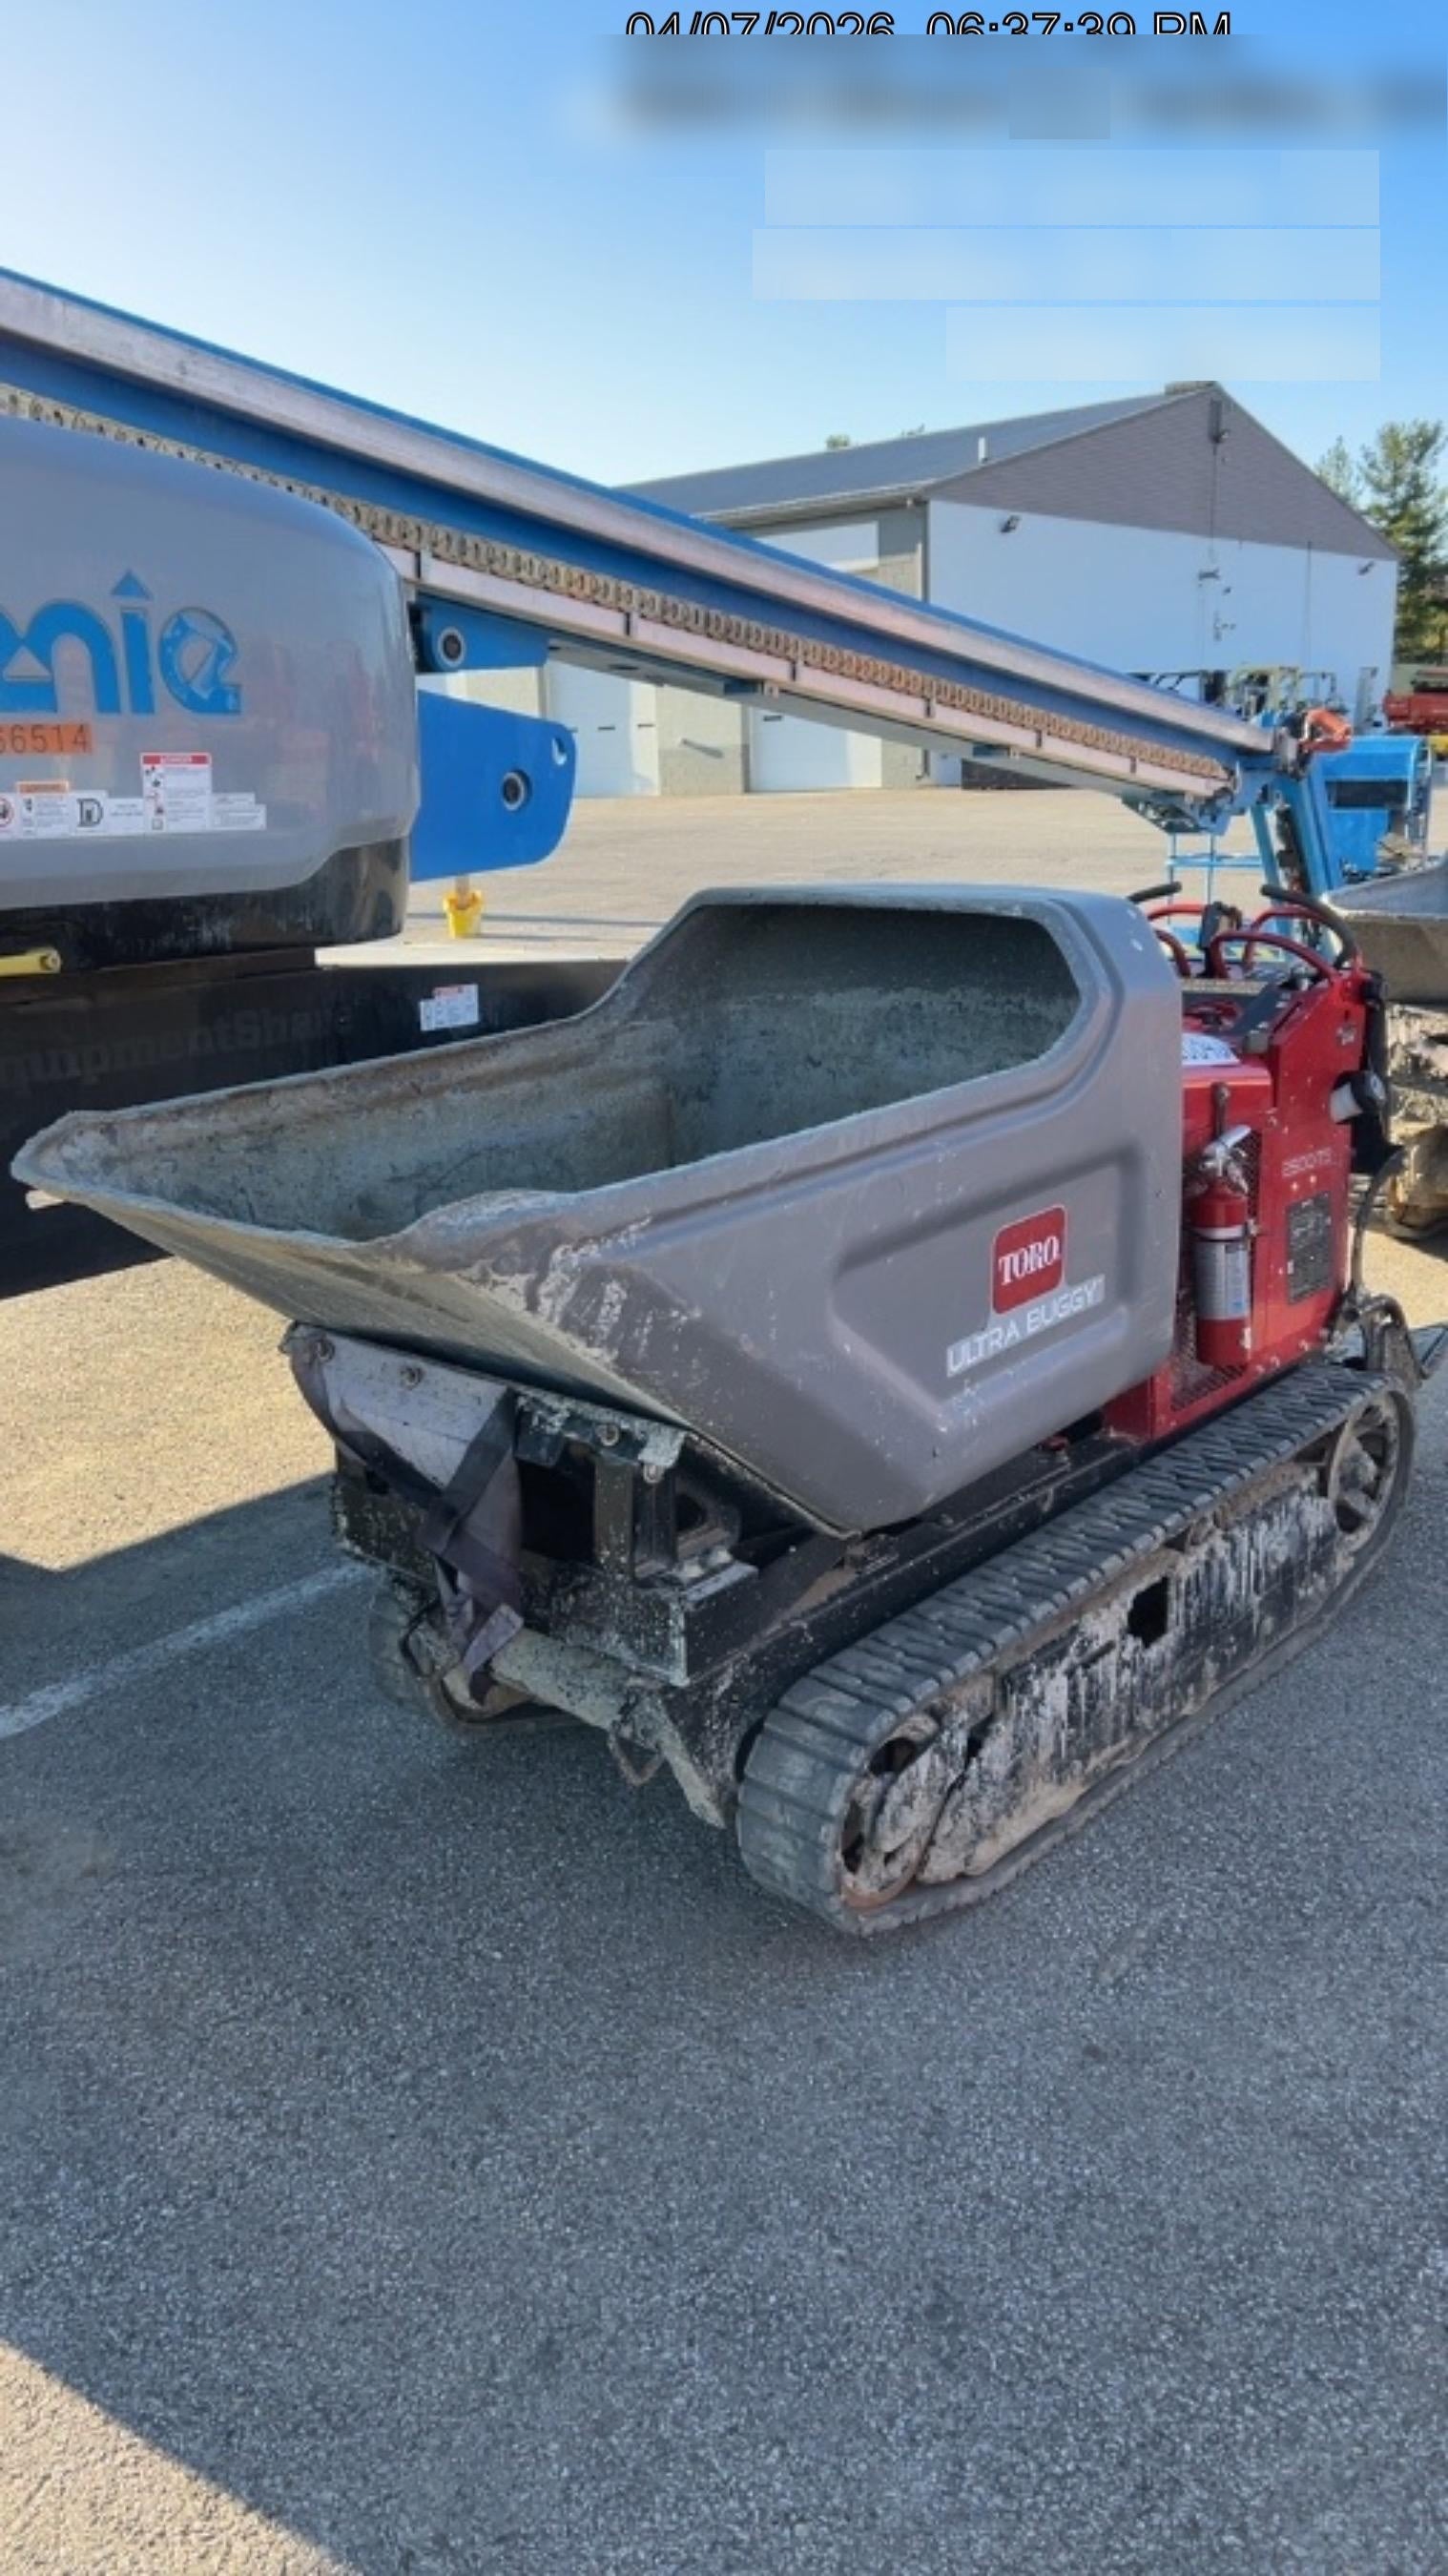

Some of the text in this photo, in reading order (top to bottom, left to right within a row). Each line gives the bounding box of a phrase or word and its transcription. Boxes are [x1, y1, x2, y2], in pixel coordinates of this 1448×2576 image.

[998, 1235, 1062, 1285] TORO
[947, 1278, 1099, 1374] ULTRA BUGGY
